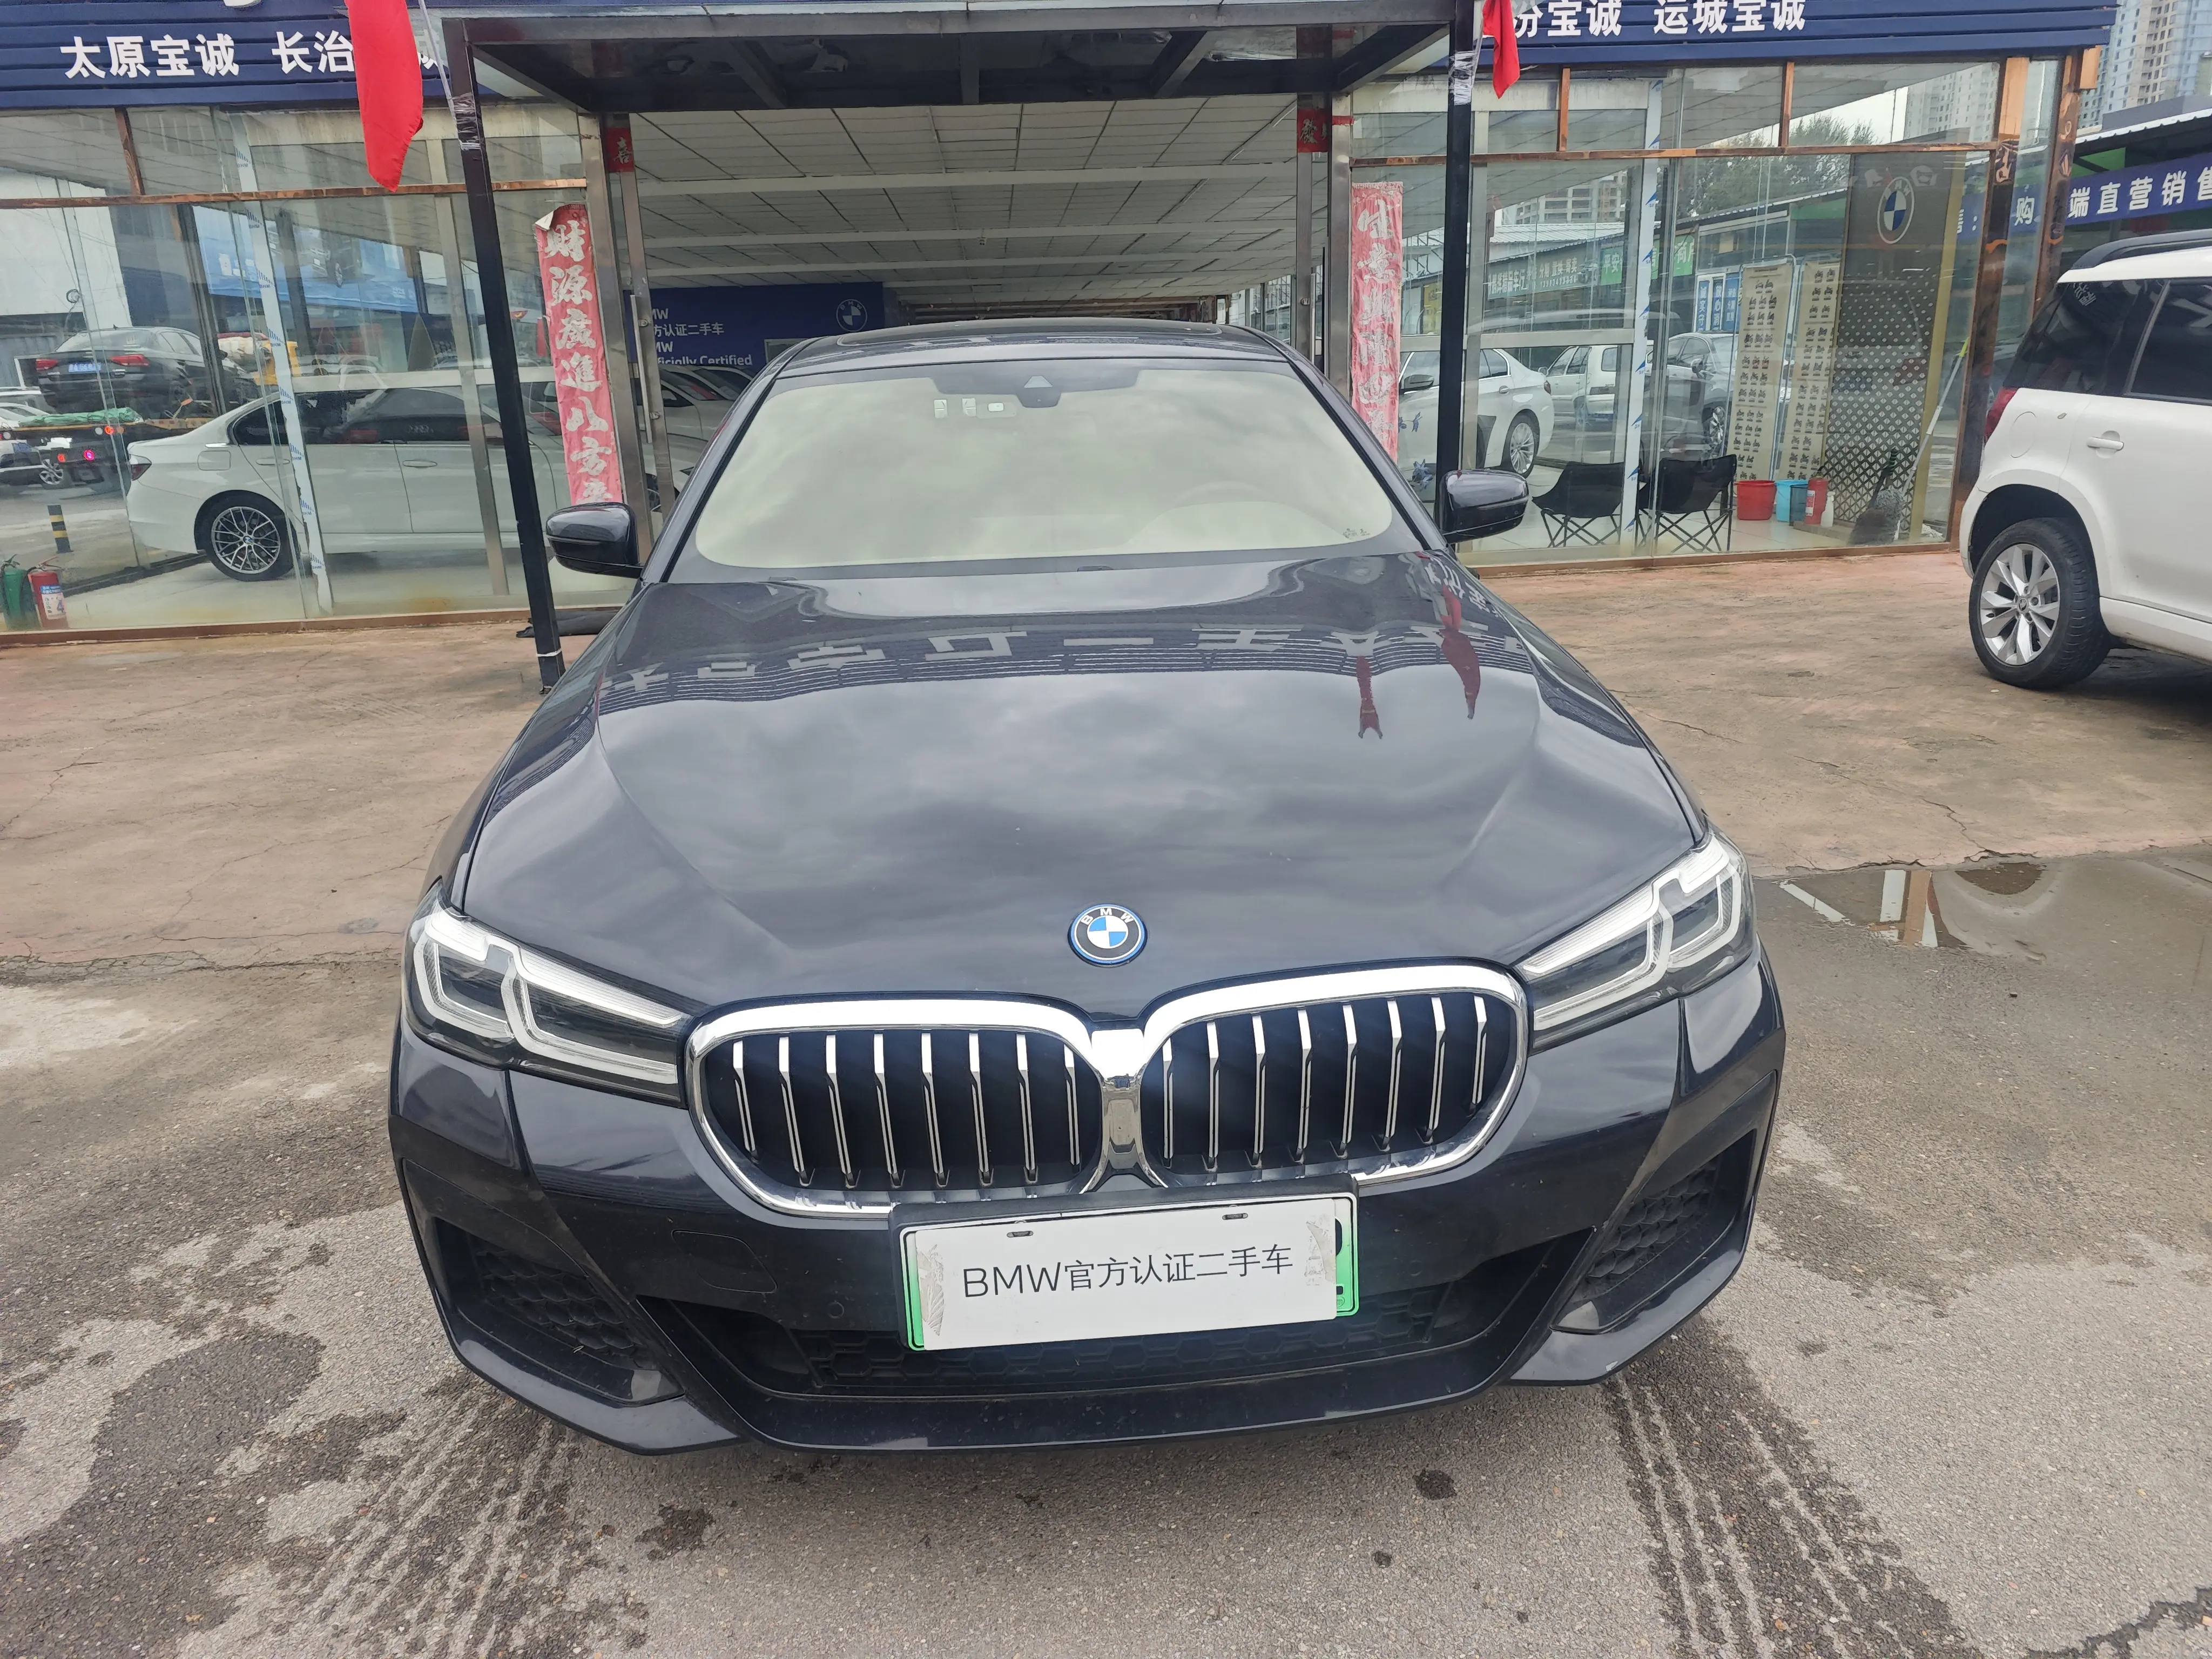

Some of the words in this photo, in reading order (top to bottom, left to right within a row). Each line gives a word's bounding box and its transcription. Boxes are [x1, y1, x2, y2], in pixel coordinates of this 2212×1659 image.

[1654, 0, 1805, 35] 运城宝诚
[59, 33, 240, 79] 太原宝诚
[653, 322, 725, 337] 方认证二手车
[699, 354, 753, 366] Certified
[1081, 908, 1136, 926] BMW
[963, 1244, 1293, 1297] BMW官方认证二手车
